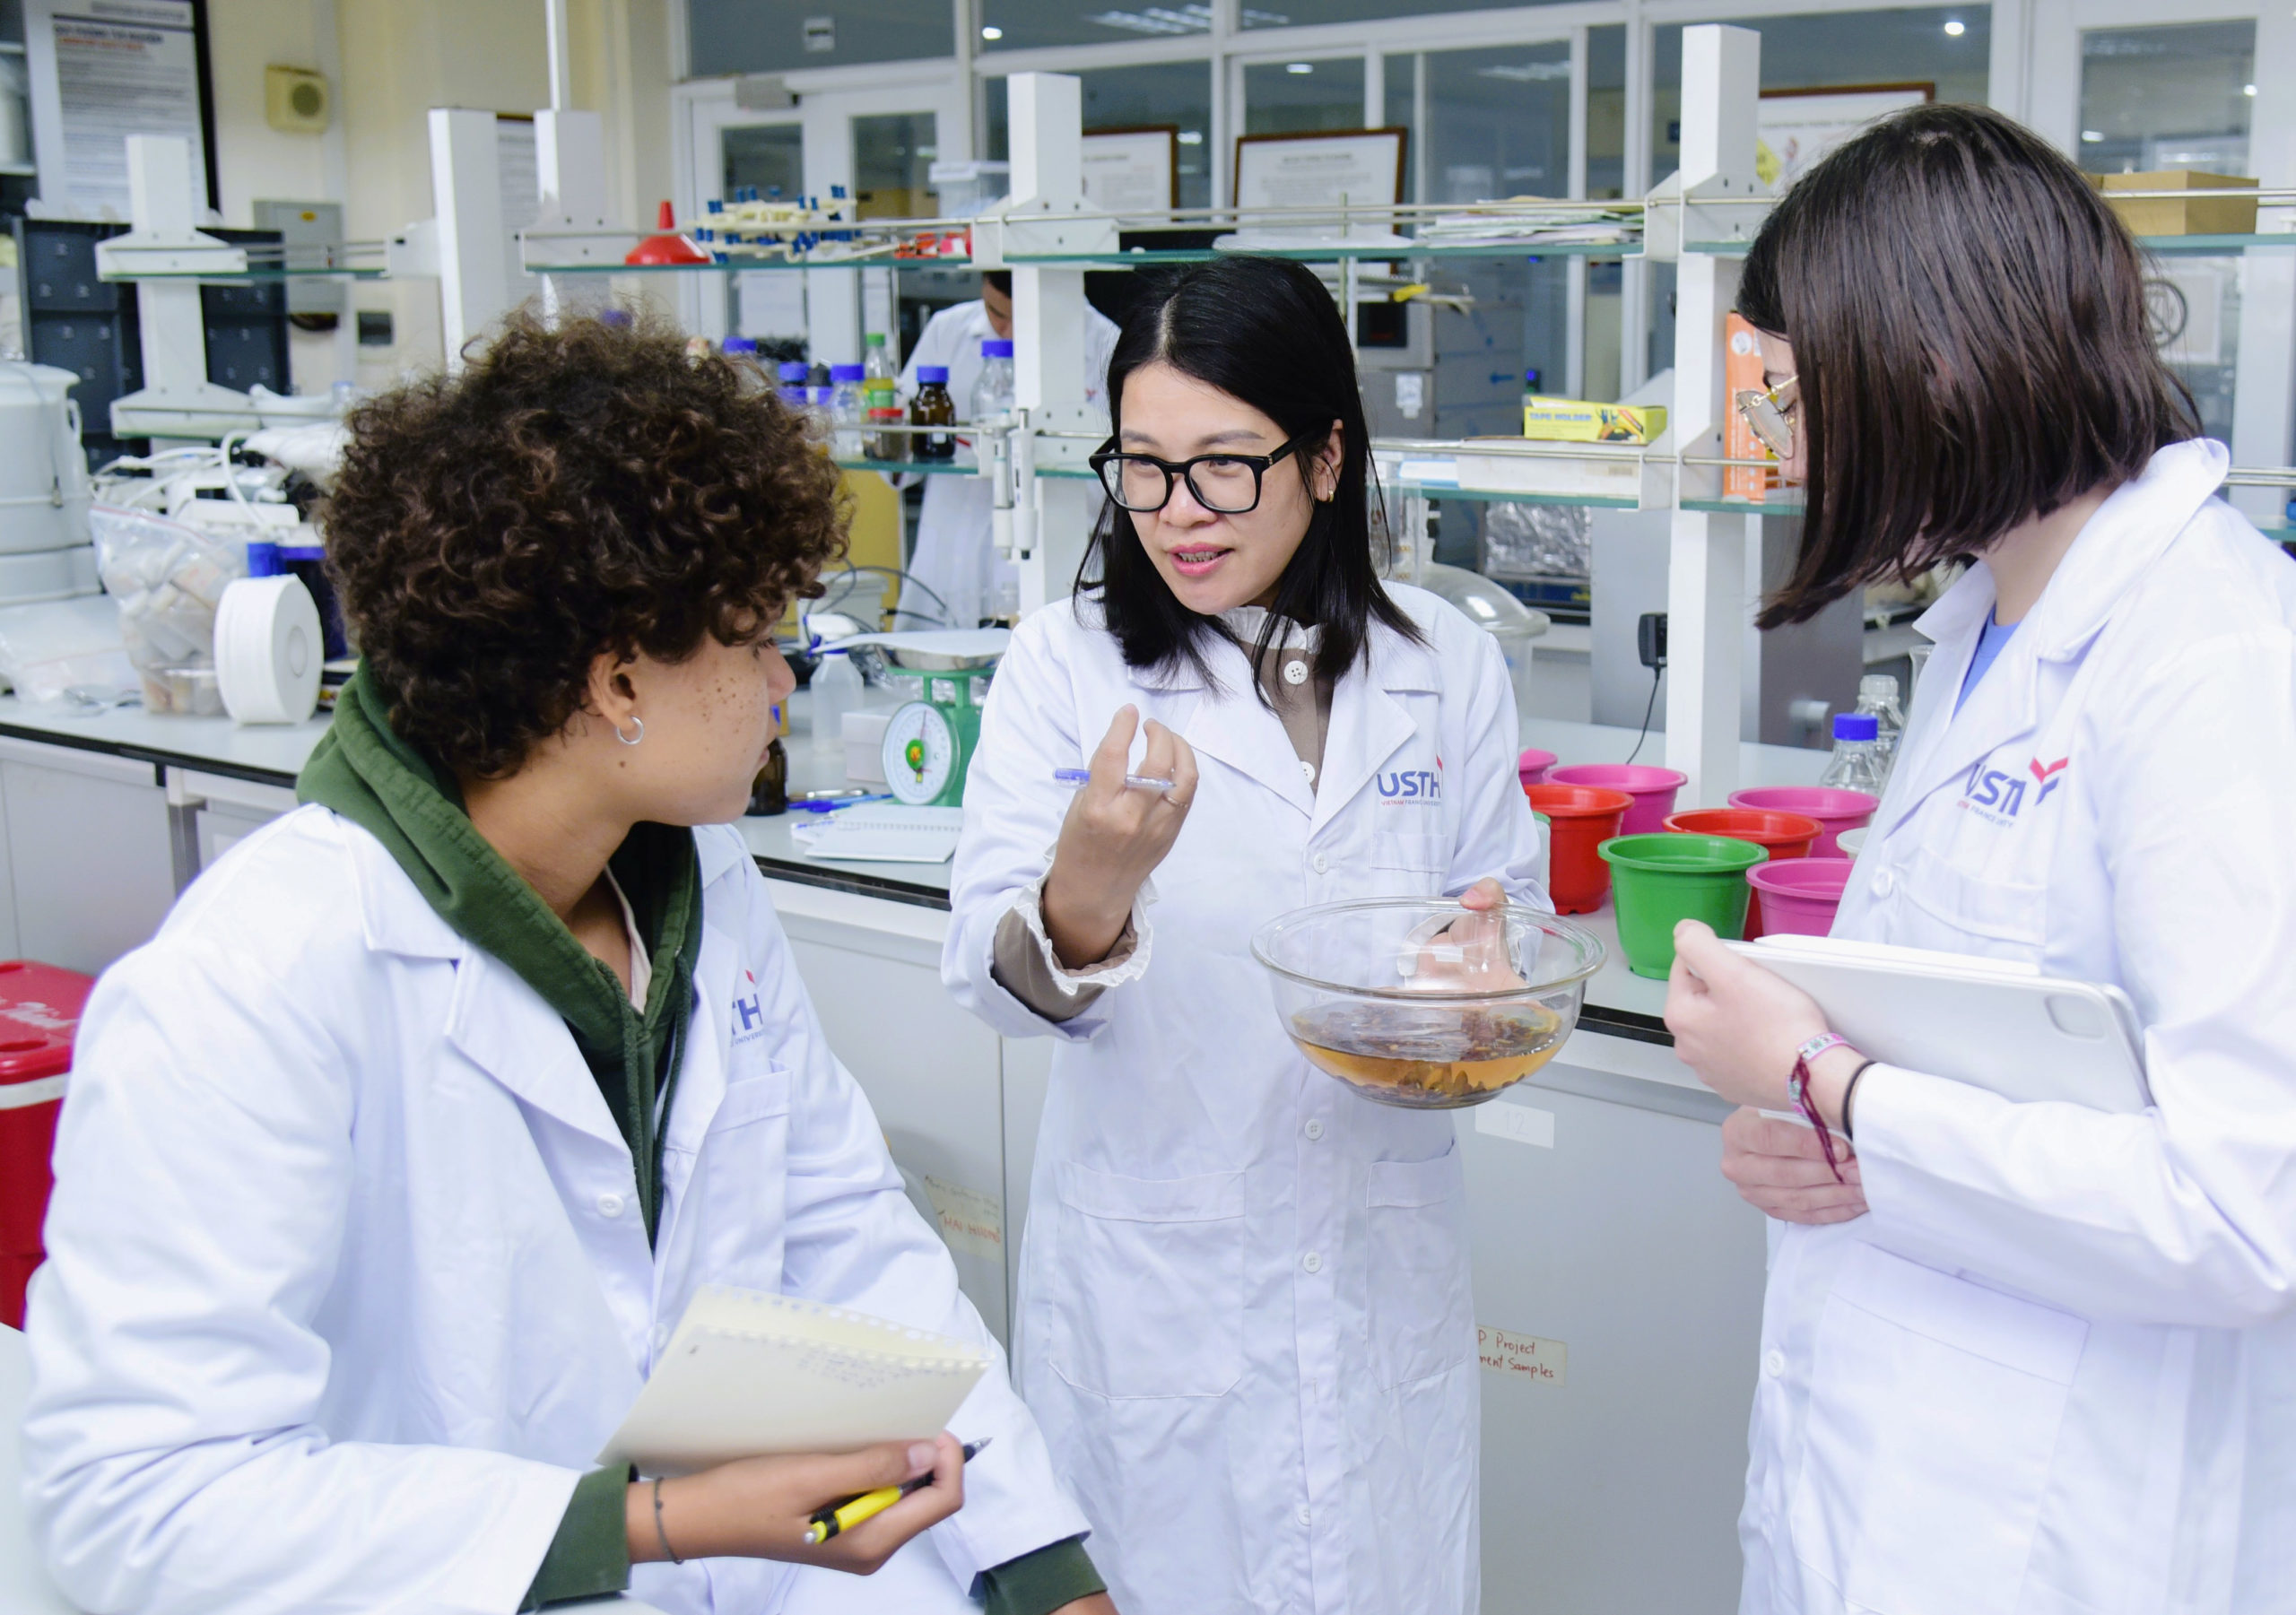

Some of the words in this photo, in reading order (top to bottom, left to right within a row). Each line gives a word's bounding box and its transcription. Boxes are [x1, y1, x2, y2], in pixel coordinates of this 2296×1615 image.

[1529, 412, 1552, 421] TAPE
[1555, 413, 1592, 421] HOLDER
[1377, 770, 1440, 798] USTH
[1505, 1110, 1529, 1135] 12
[1478, 1329, 1486, 1345] P
[1496, 1332, 1535, 1355] Project
[1509, 1357, 1553, 1379] Samples
